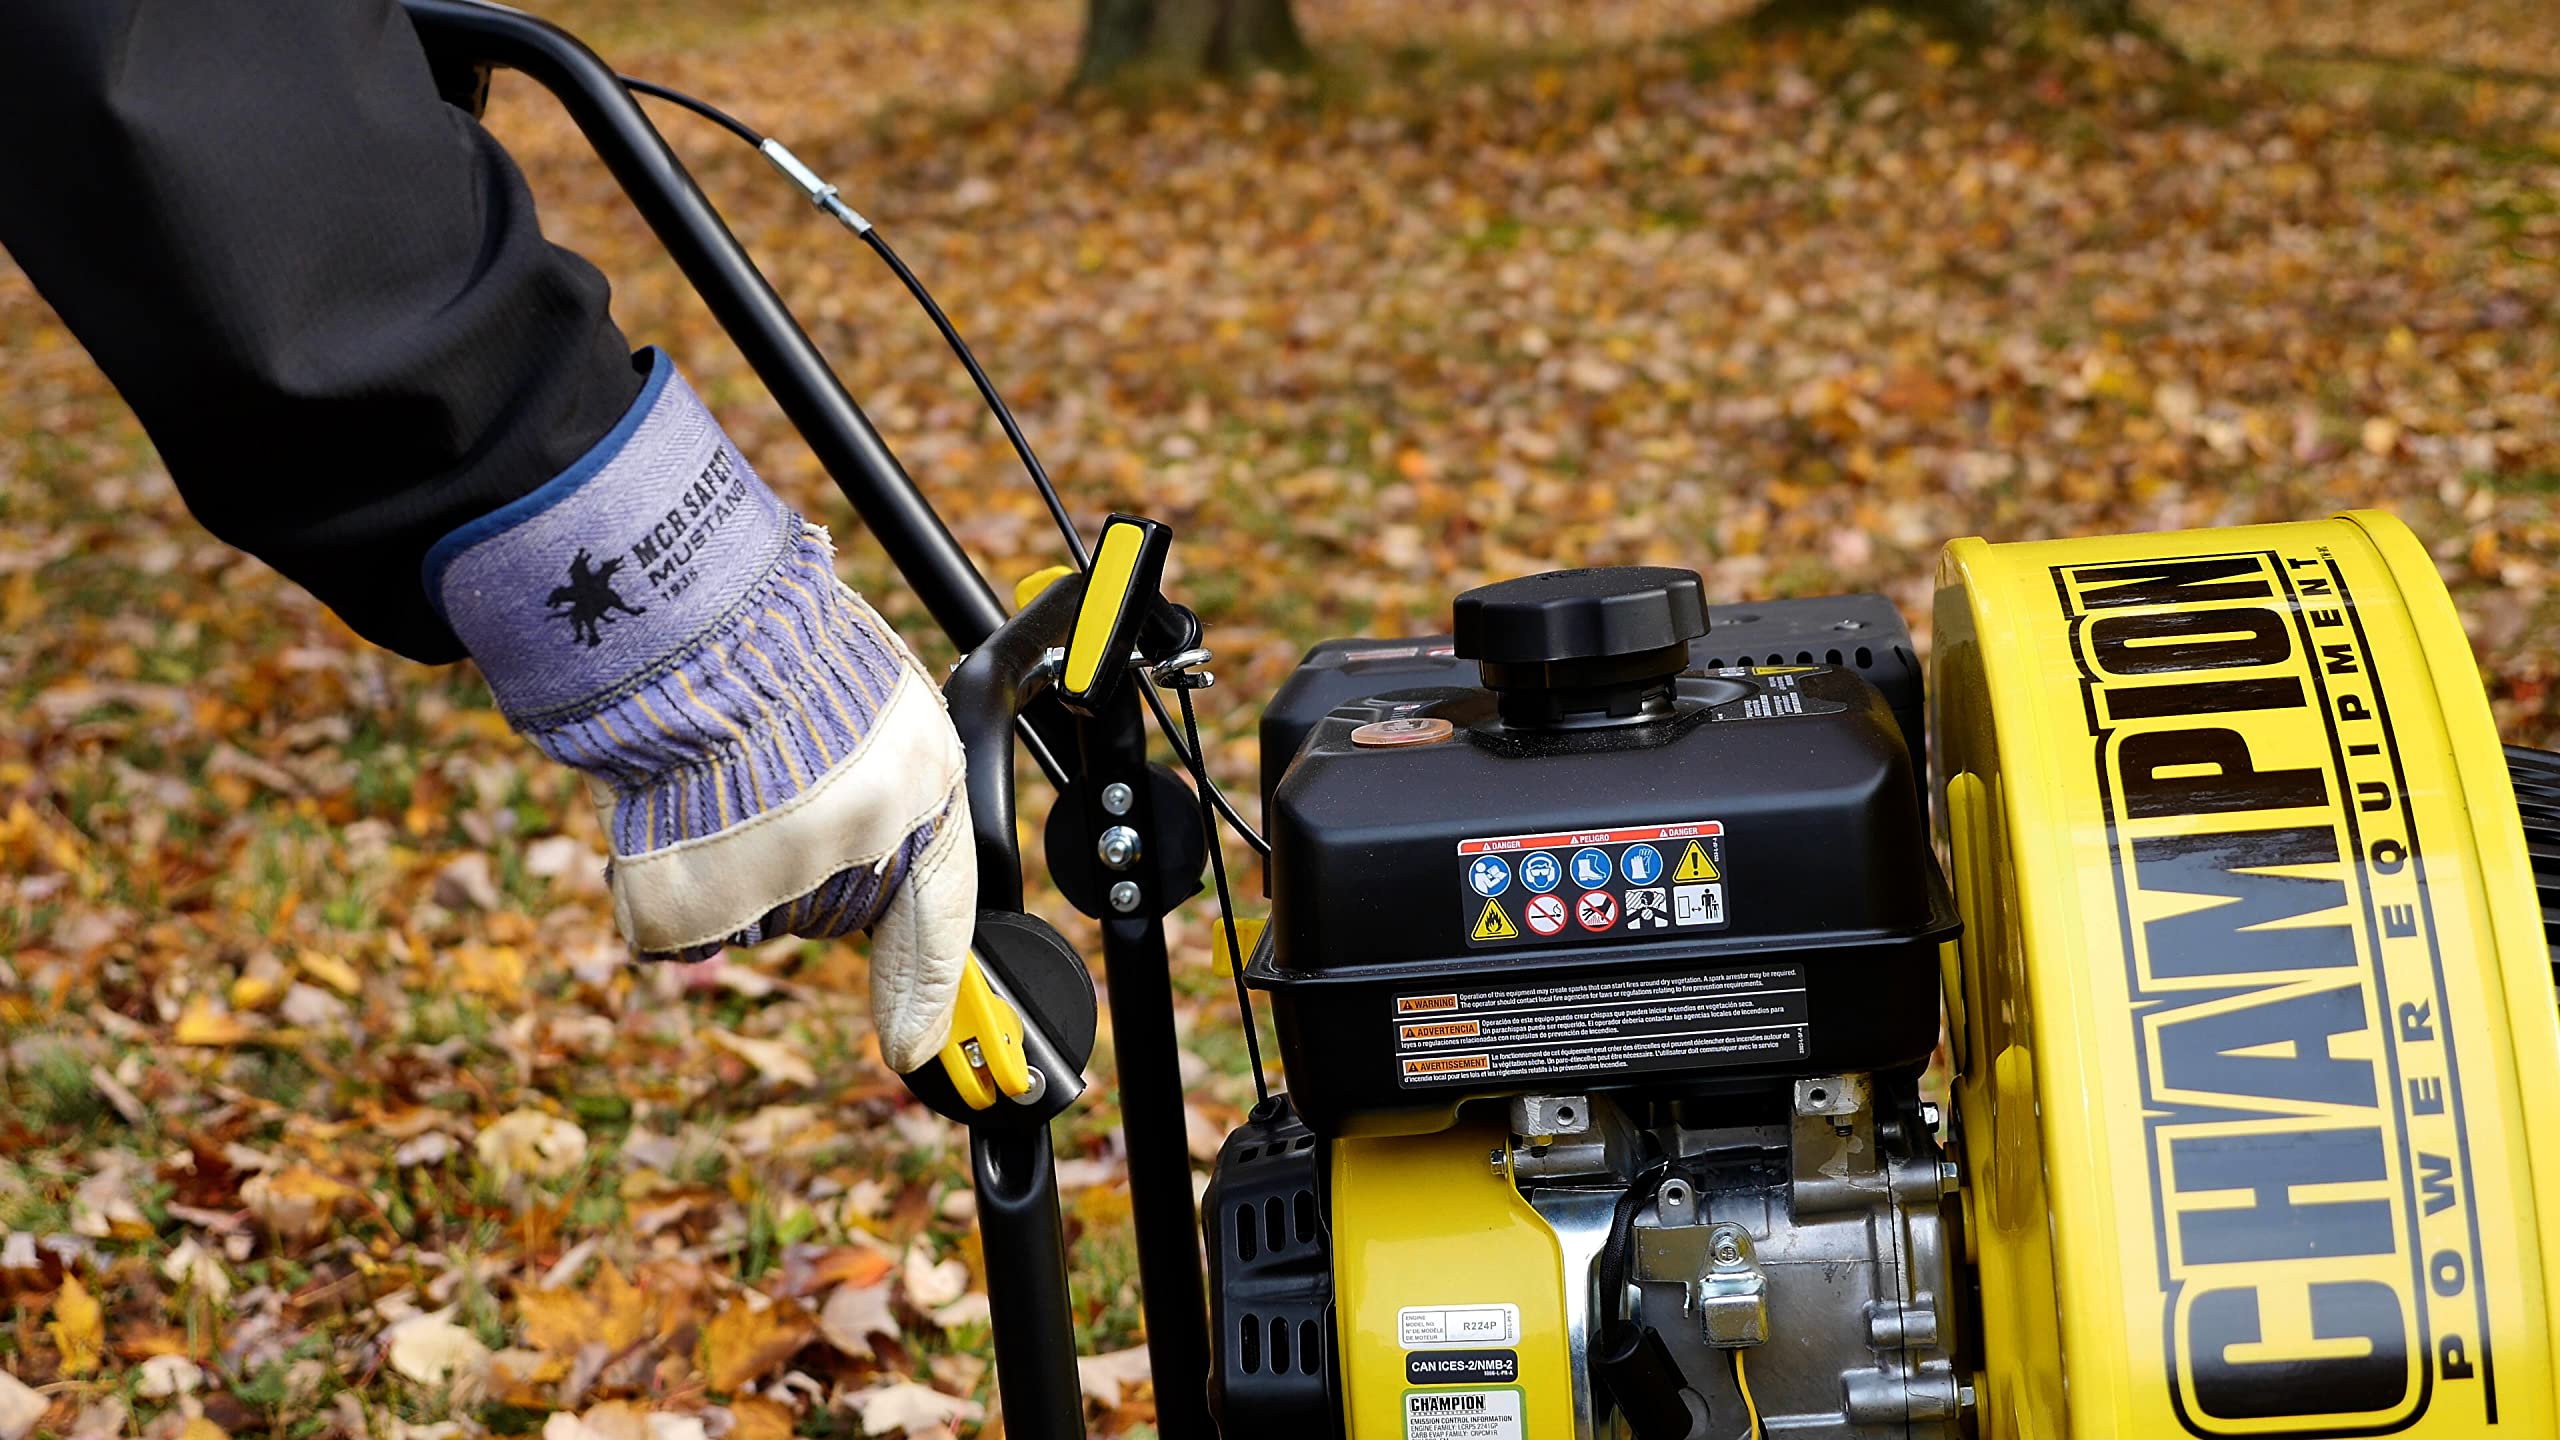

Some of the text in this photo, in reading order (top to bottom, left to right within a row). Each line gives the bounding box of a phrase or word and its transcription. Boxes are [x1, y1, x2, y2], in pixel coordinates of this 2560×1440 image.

[632, 507, 688, 569] MCR
[648, 478, 747, 588] MUSTANG
[1668, 827, 1698, 836] DANGER
[1492, 840, 1521, 850] DANGER
[1579, 834, 1610, 843] PELIGRO
[2286, 557, 2475, 1381] POWER EQUIPMENT
[1459, 992, 1487, 1002] Operation
[1506, 988, 1535, 998] equipment
[1549, 986, 1568, 994] create
[1568, 984, 1588, 994] sparks
[1588, 983, 1600, 991] that
[1626, 980, 1639, 988] fires
[1640, 979, 1660, 987] around
[1660, 978, 1671, 987] dry
[1709, 974, 1725, 983] spark
[1725, 972, 1749, 981] arrestor
[2066, 555, 2415, 1424] CHAMPION
[1460, 1001, 1471, 1009] The
[1472, 999, 1496, 1009] operator
[1497, 998, 1516, 1006] should
[1516, 996, 1538, 1004] contact
[1539, 995, 1552, 1003] local
[1553, 994, 1563, 1002] fire
[1564, 992, 1589, 1002] agencies
[1590, 991, 1598, 999] for
[1599, 990, 1613, 998] laws
[1620, 987, 1652, 998] regulations
[1653, 986, 1675, 995] relating
[1682, 984, 1692, 992] fire
[1693, 982, 1723, 992] prevention
[1414, 999, 1454, 1009] WARNING
[1417, 1024, 1475, 1037] ADVERTENCIA
[1420, 1059, 1486, 1071] AVERTISSEMENT
[1463, 1321, 1497, 1330] R224P
[1412, 1360, 1513, 1372] CAN ICES-2/NMB-2
[1411, 1396, 1484, 1412] CHAMPION
